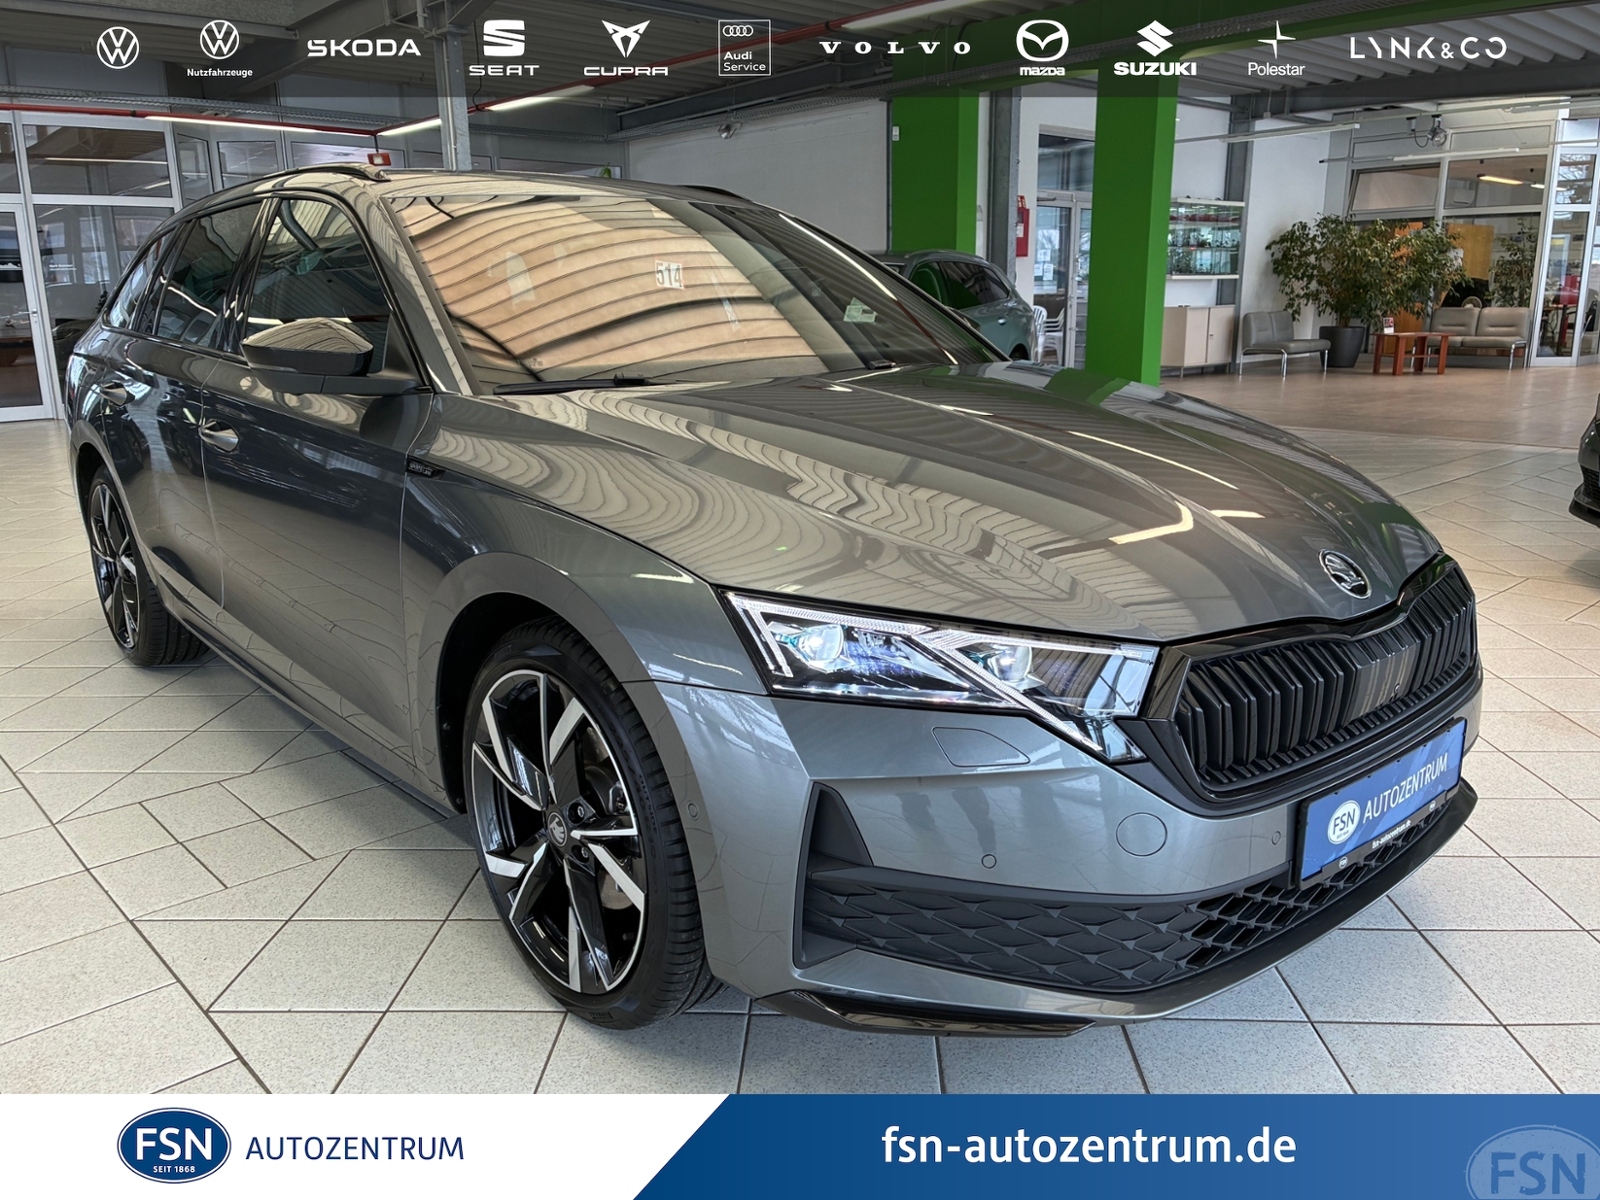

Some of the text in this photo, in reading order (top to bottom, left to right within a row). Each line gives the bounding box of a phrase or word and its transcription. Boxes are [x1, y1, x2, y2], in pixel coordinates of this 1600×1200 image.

[656, 262, 682, 288] 514
[1362, 752, 1448, 824] AUTOZENTRUM
[1333, 808, 1356, 835] FSN
